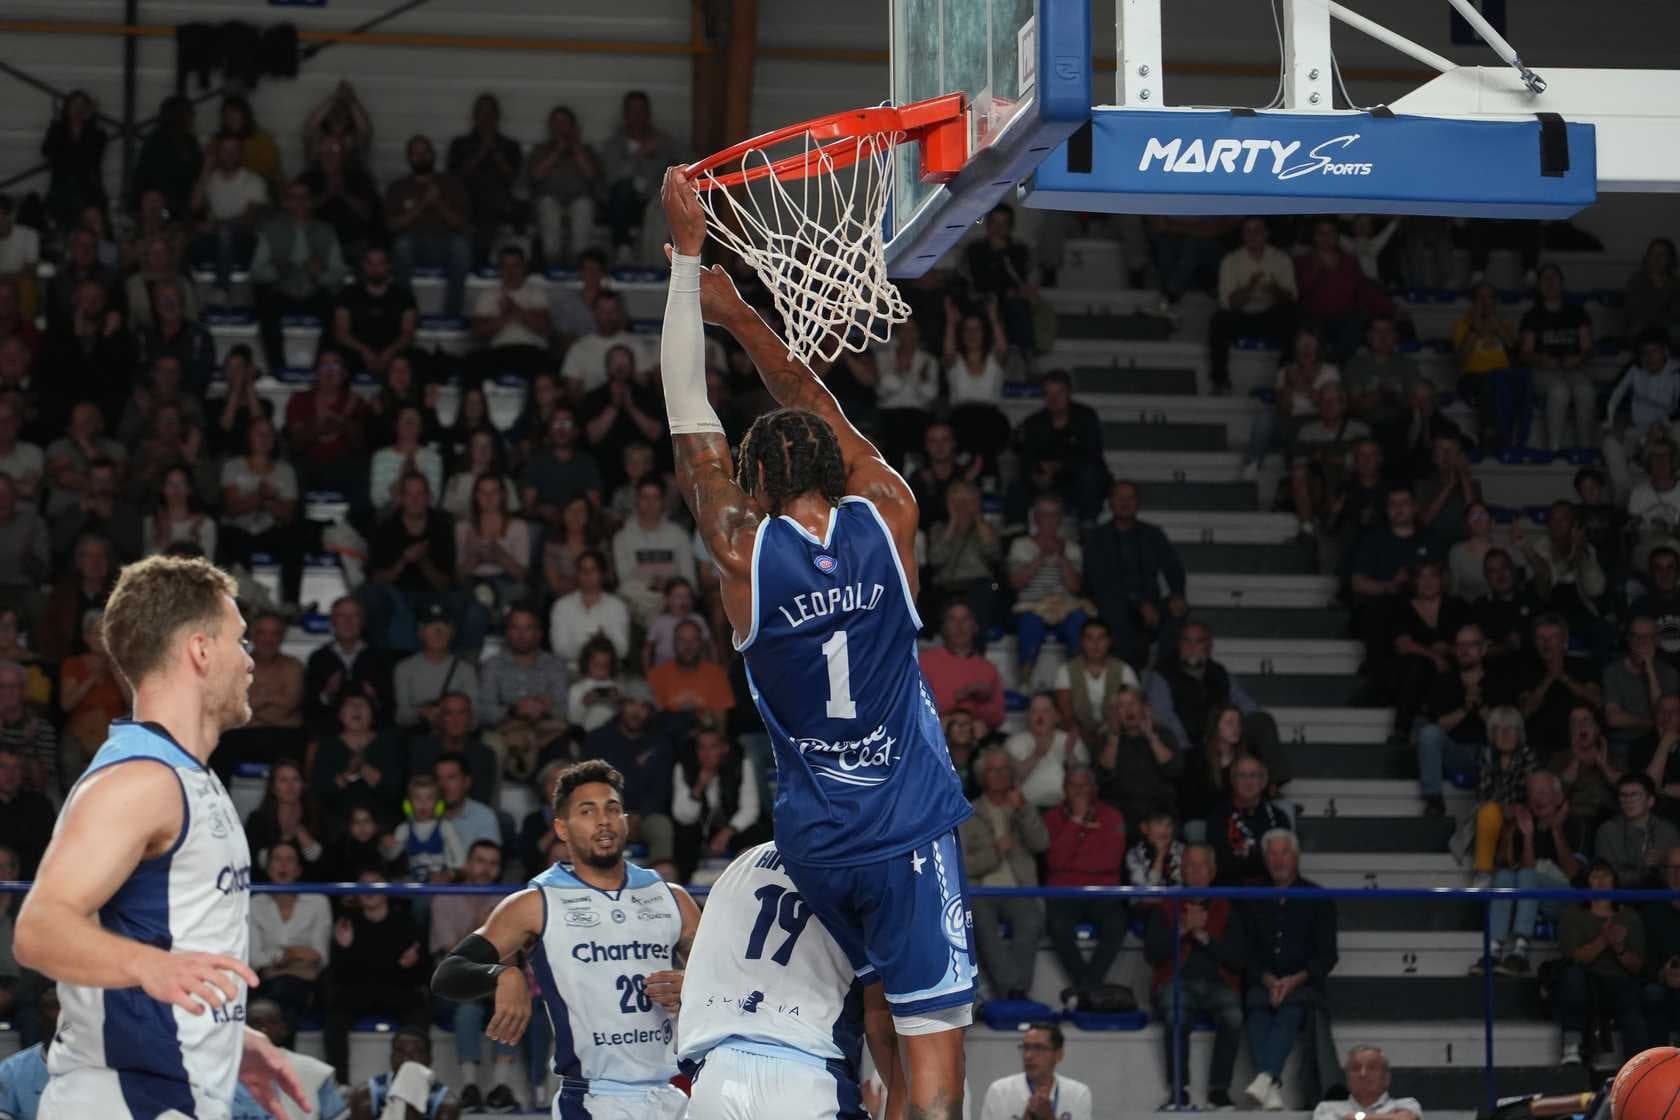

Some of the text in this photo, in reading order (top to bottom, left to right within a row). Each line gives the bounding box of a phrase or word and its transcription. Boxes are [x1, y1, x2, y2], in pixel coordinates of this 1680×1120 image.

[1138, 137, 1301, 173] MARTY
[778, 581, 885, 628] LEOPOLD
[821, 629, 857, 719] 1
[744, 883, 809, 967] 19
[1402, 952, 1417, 973] 2
[616, 974, 653, 1014] 28
